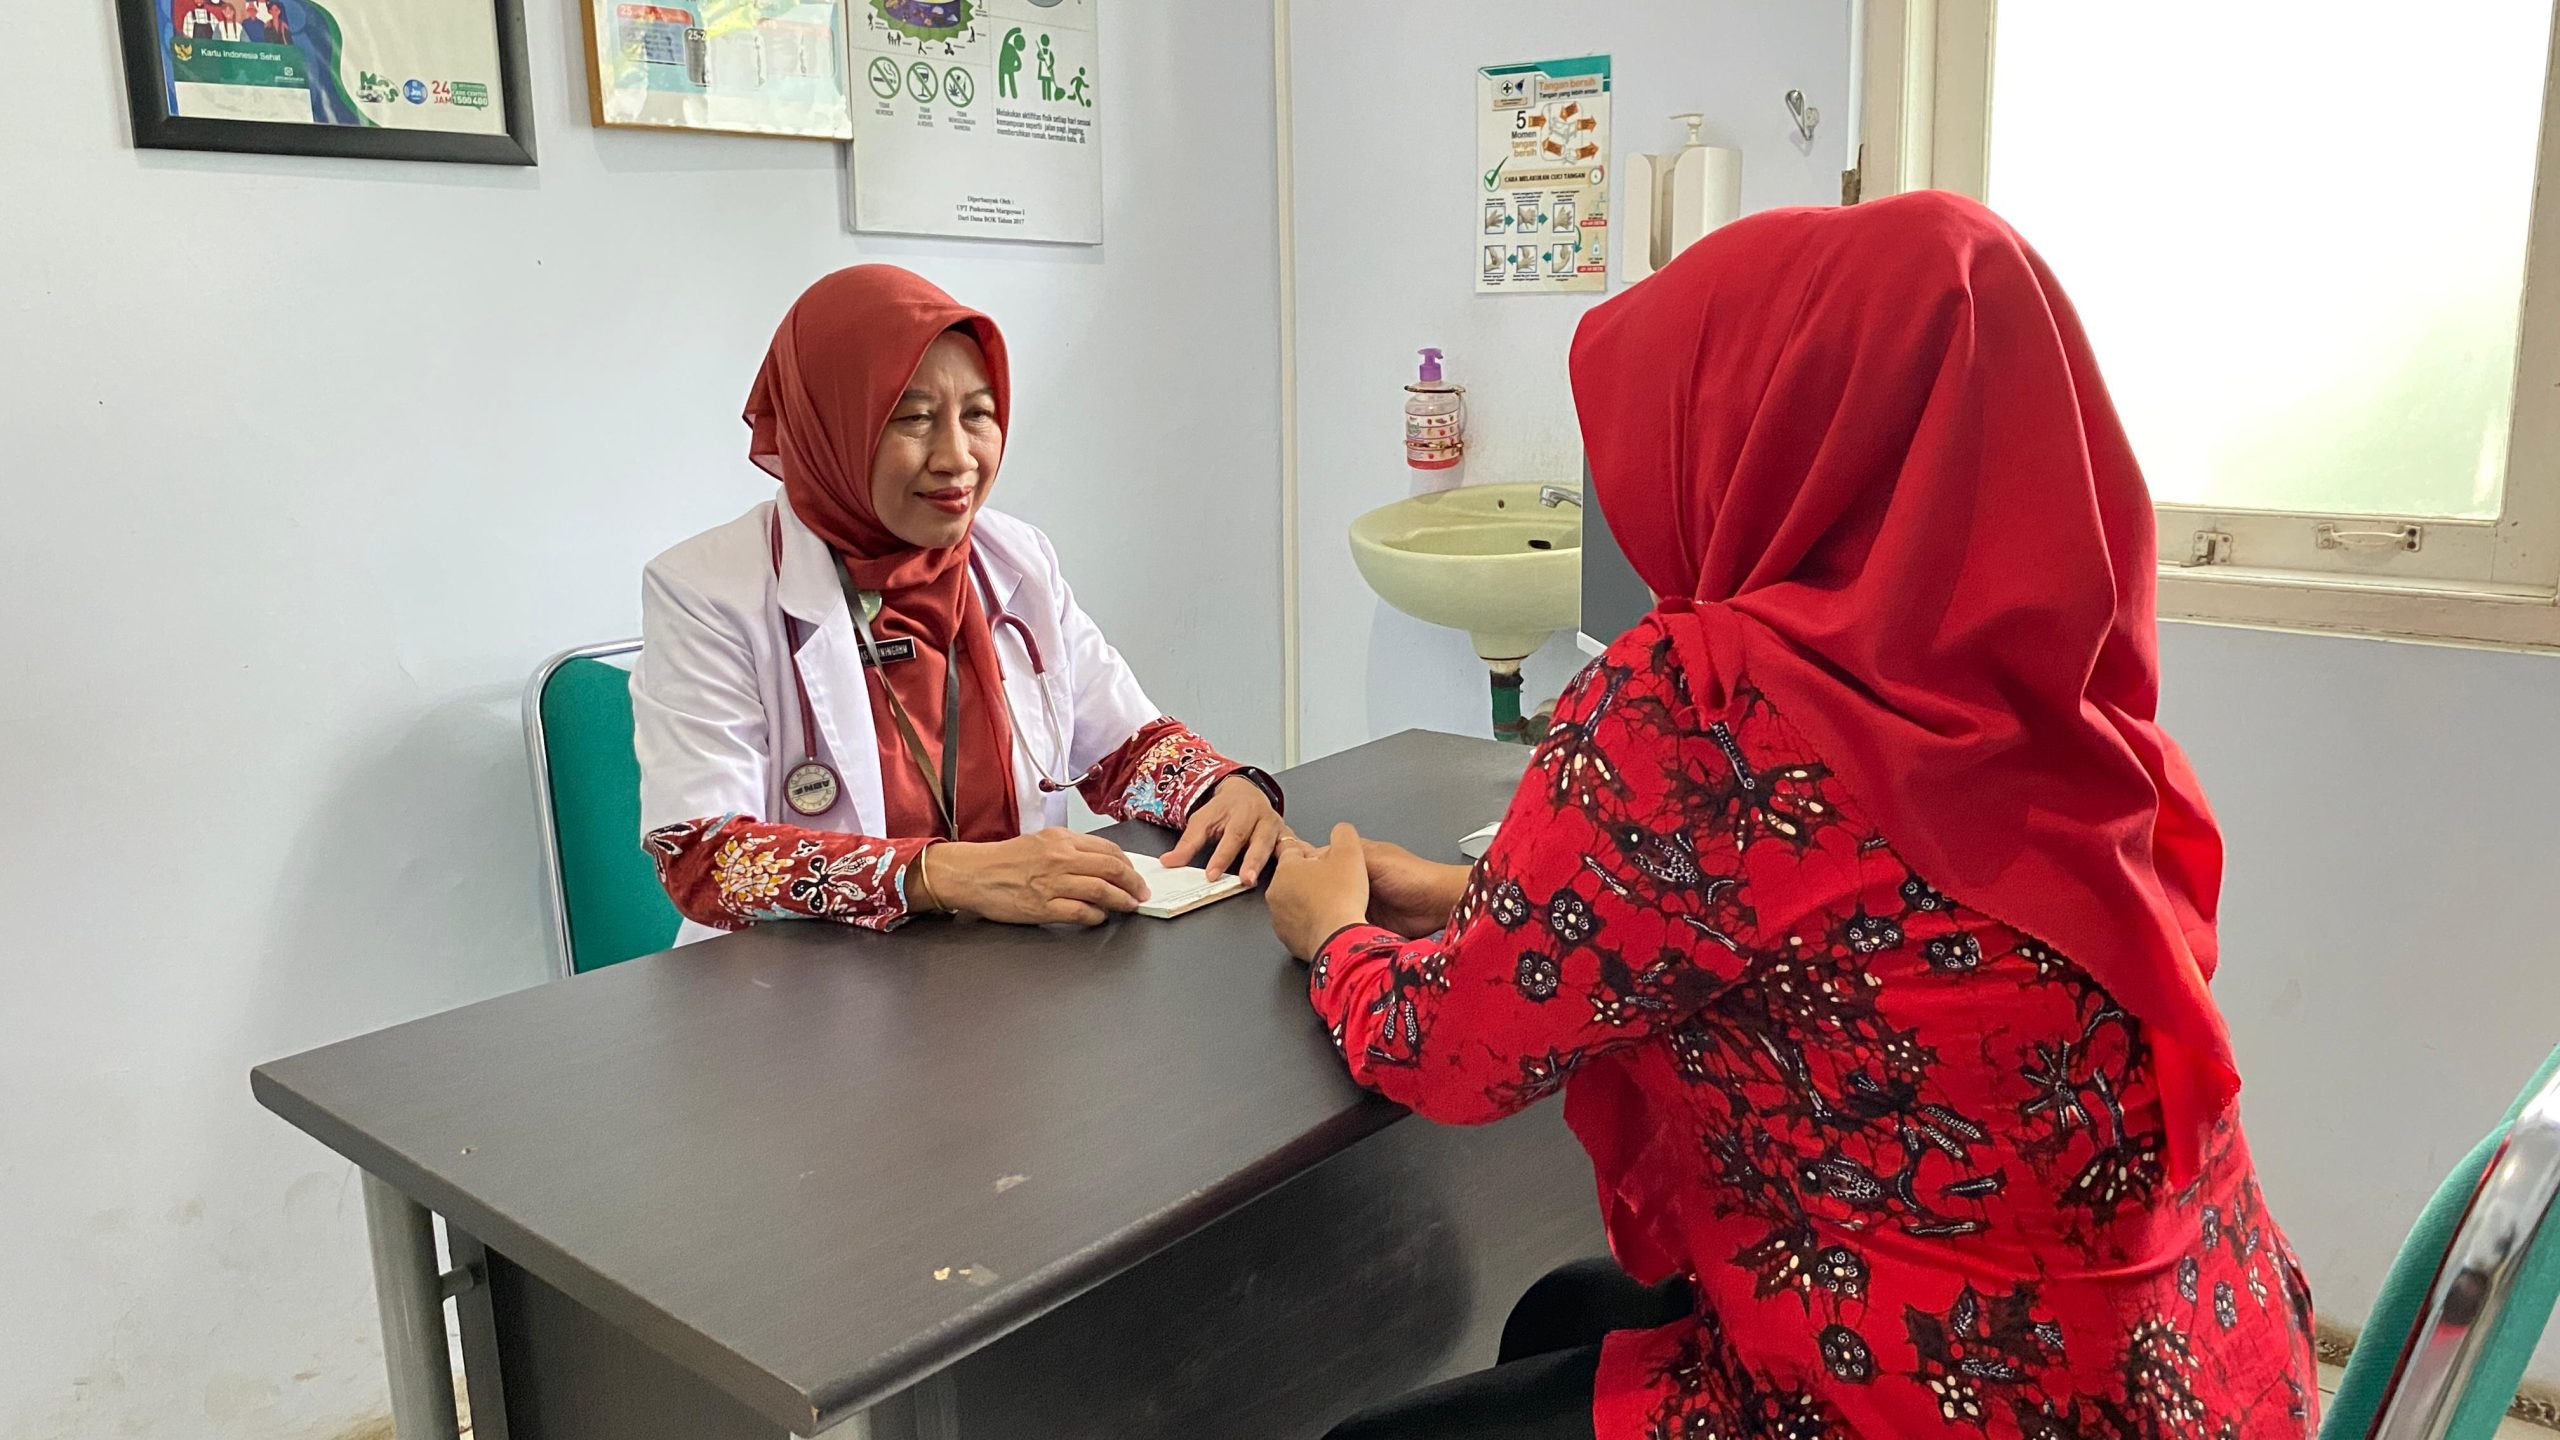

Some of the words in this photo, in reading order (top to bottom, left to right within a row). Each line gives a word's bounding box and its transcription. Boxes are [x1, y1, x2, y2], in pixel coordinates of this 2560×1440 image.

[201, 48, 221, 57] Kartu
[223, 50, 258, 60] Indonesia
[259, 52, 281, 61] Sehat
[431, 80, 450, 95] 24
[1539, 81, 1569, 92] Tangan
[1570, 77, 1596, 88] bersih
[434, 95, 452, 104] JAM
[473, 97, 488, 105] 400
[1516, 110, 1526, 129] 5
[1511, 131, 1537, 139] Momen
[1511, 140, 1537, 150] tangan
[1513, 149, 1537, 157] bersih
